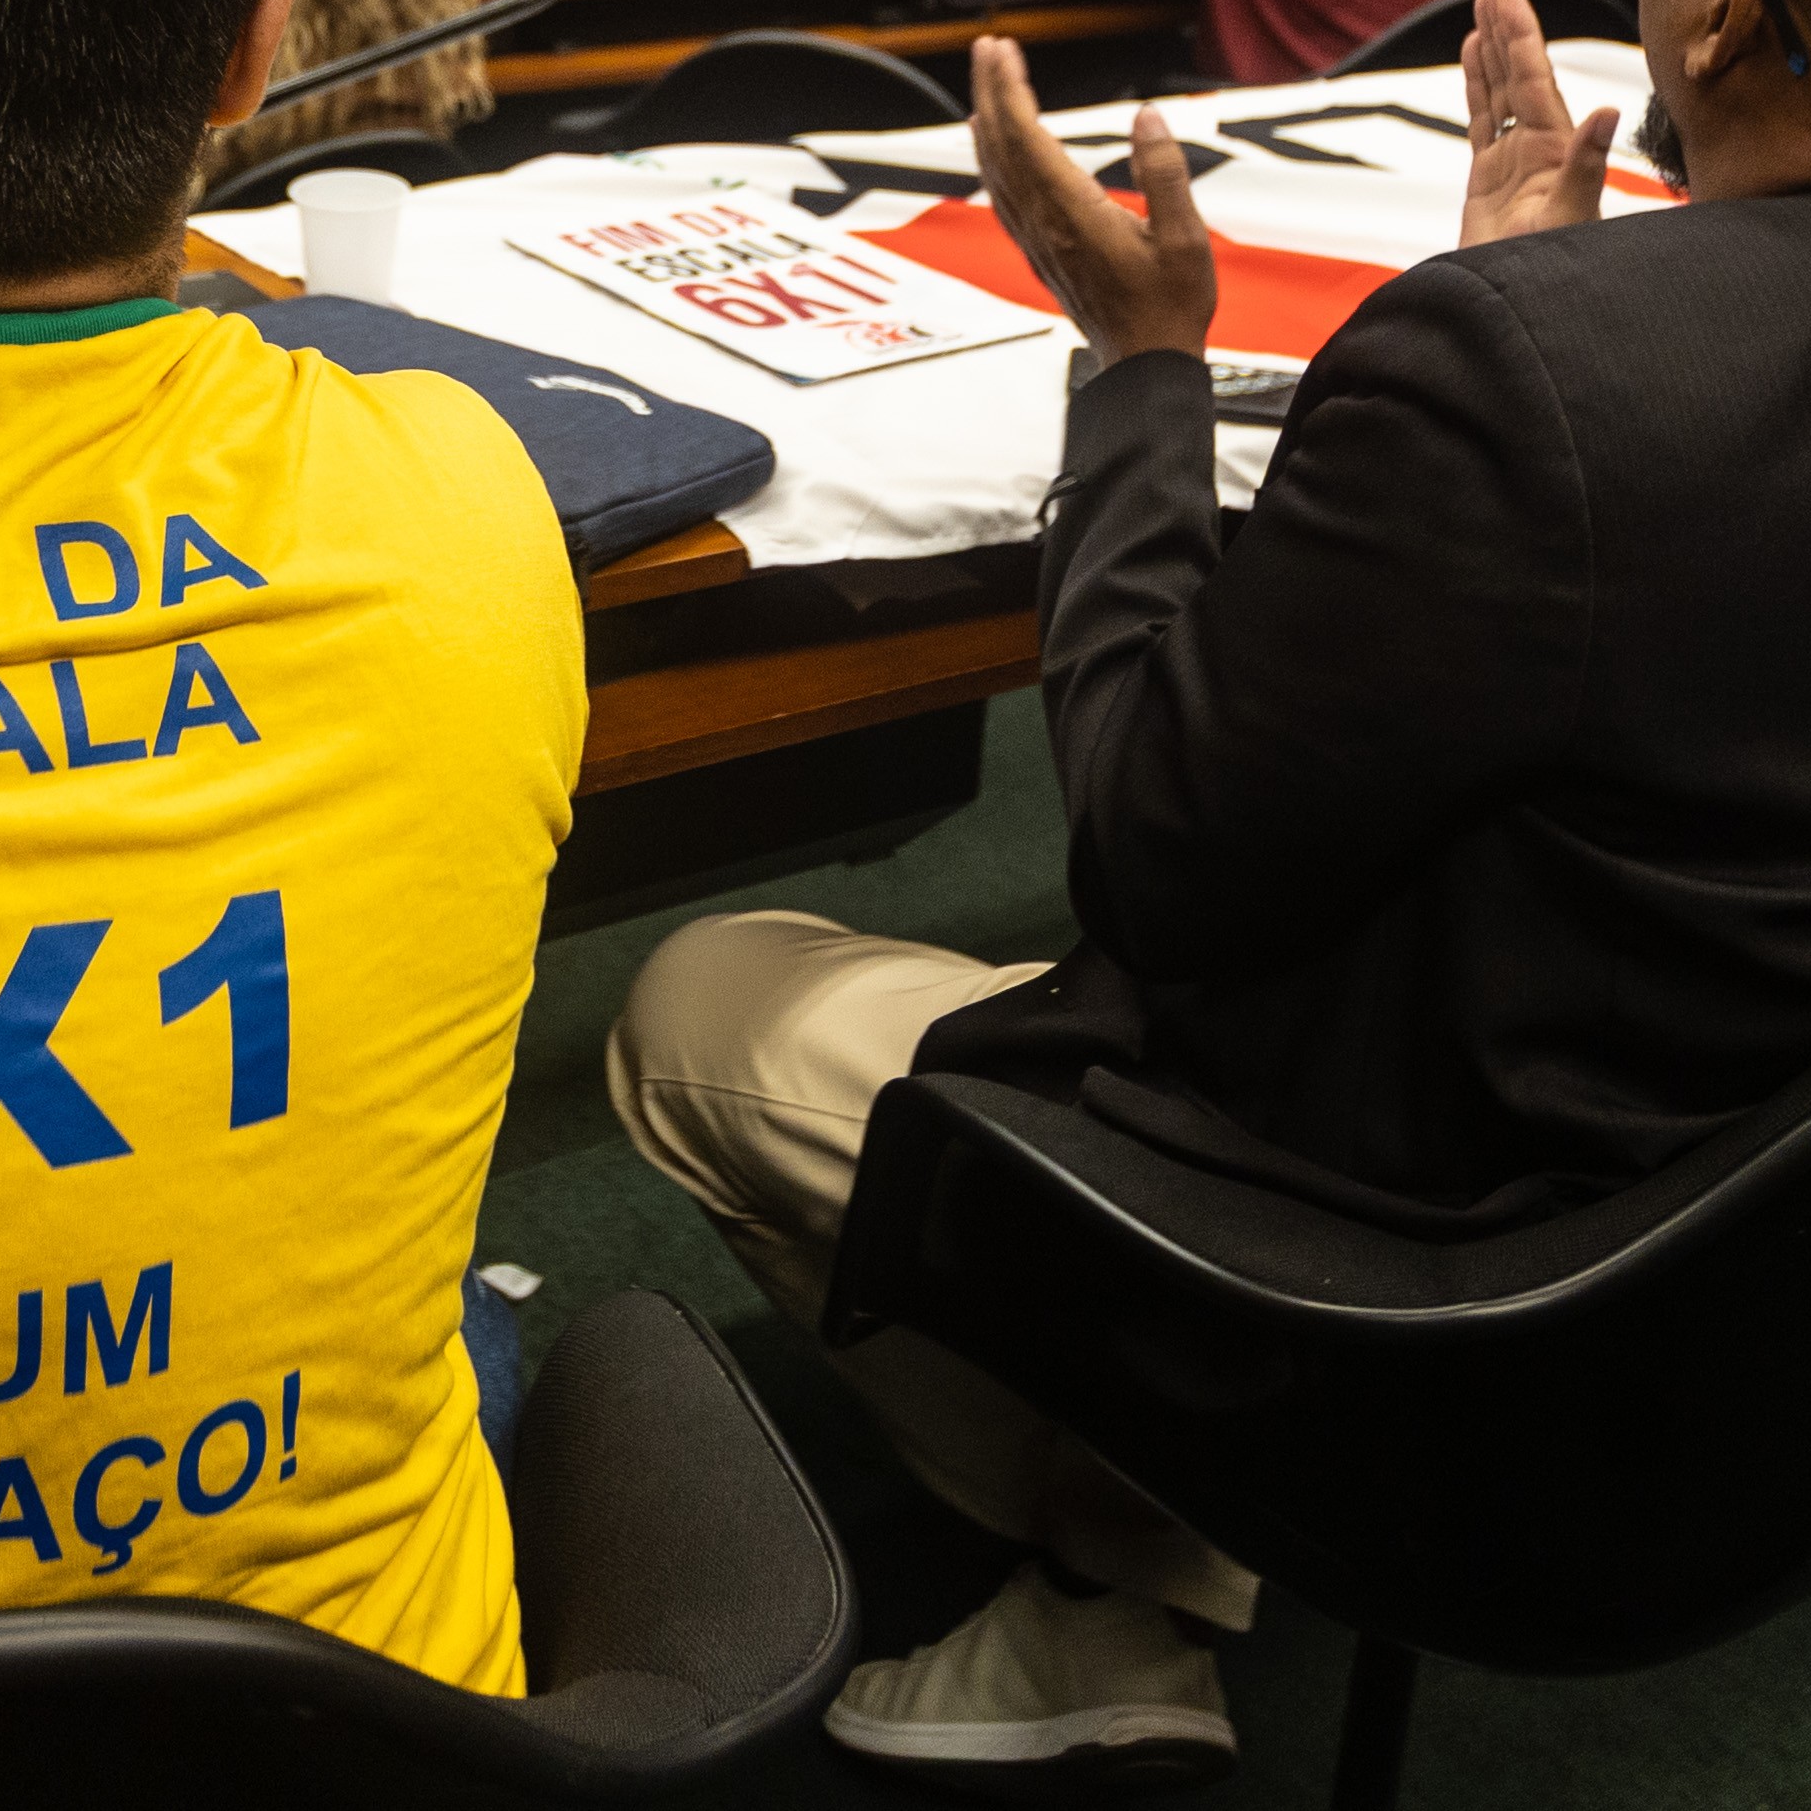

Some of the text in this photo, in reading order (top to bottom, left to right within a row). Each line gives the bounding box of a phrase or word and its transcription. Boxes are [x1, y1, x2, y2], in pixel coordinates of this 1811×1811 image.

[559, 204, 768, 258] FIM DA
[613, 232, 826, 283] ESCALA
[36, 514, 267, 621] DA
